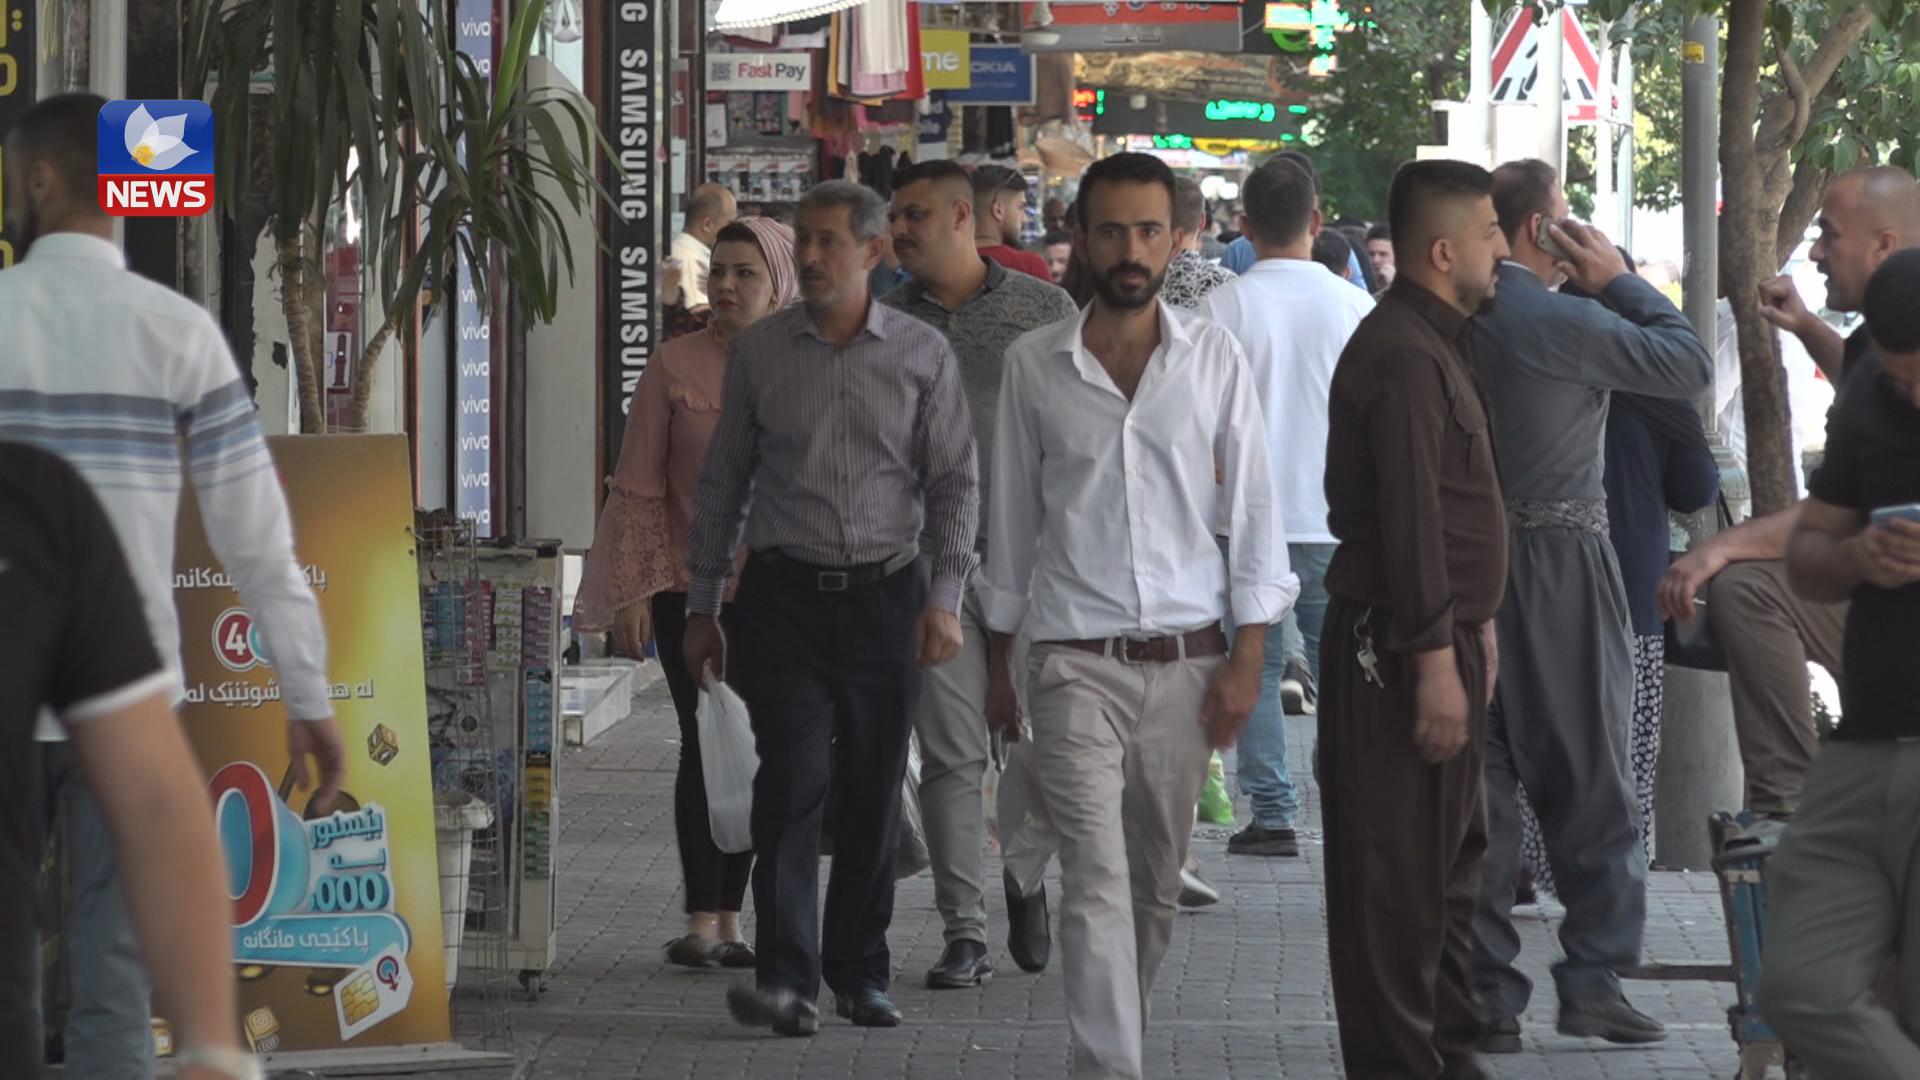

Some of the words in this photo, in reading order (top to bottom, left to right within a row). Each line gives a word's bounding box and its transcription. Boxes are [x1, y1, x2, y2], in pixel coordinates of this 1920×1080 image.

[461, 17, 490, 36] vivo
[738, 63, 773, 79] Fast
[775, 63, 806, 82] Pay
[620, 48, 648, 220] SAMSUNG
[461, 321, 490, 340] vivo
[461, 358, 490, 377] vivo
[461, 395, 490, 414] vivo
[461, 432, 490, 451] vivo
[461, 468, 490, 488] vivo
